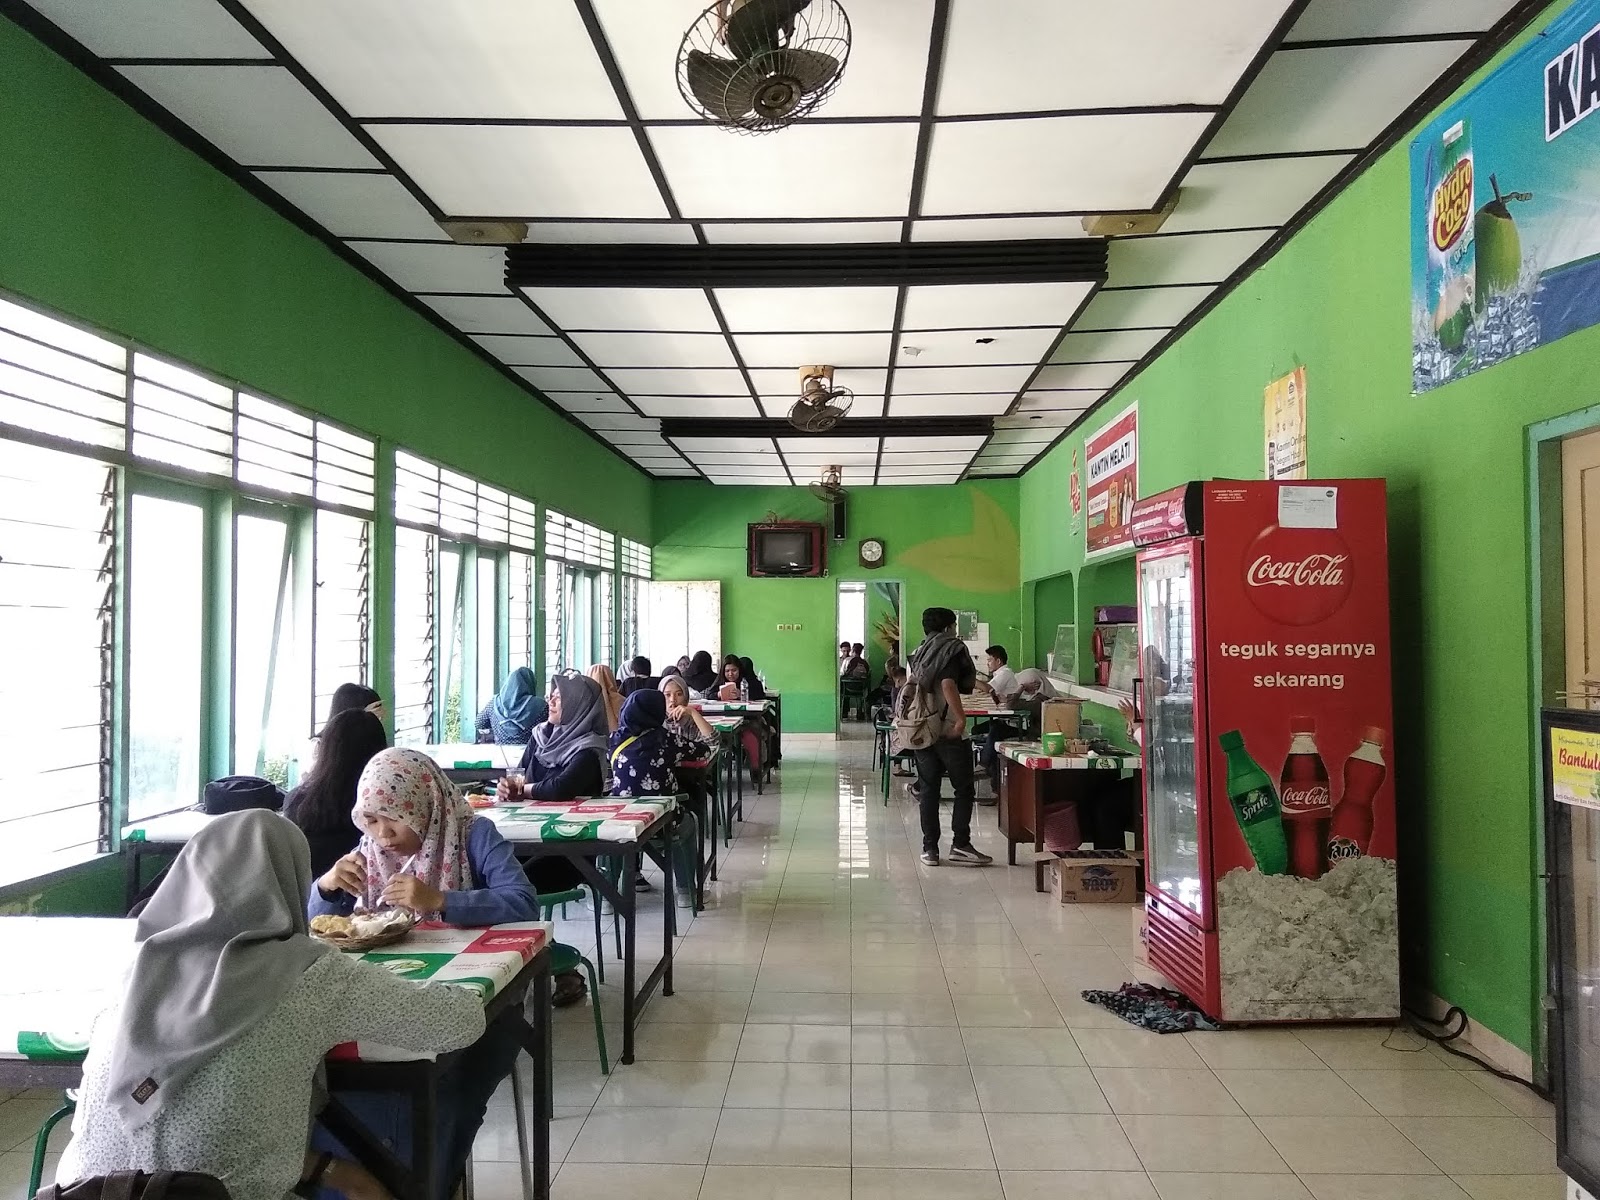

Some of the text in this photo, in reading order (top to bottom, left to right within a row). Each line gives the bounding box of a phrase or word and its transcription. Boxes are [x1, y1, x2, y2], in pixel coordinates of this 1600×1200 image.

[1435, 162, 1471, 219] Hydro
[1436, 188, 1469, 248] Coco
[1090, 440, 1131, 480] KANTIN MELATI
[1247, 554, 1349, 587] Coca-Cola
[1220, 641, 1376, 660] teguk segarnya
[1253, 671, 1345, 690] sekarang
[1242, 793, 1270, 821] Sprite
[1282, 786, 1329, 806] Coca-Cola
[1327, 838, 1362, 860] Fanta
